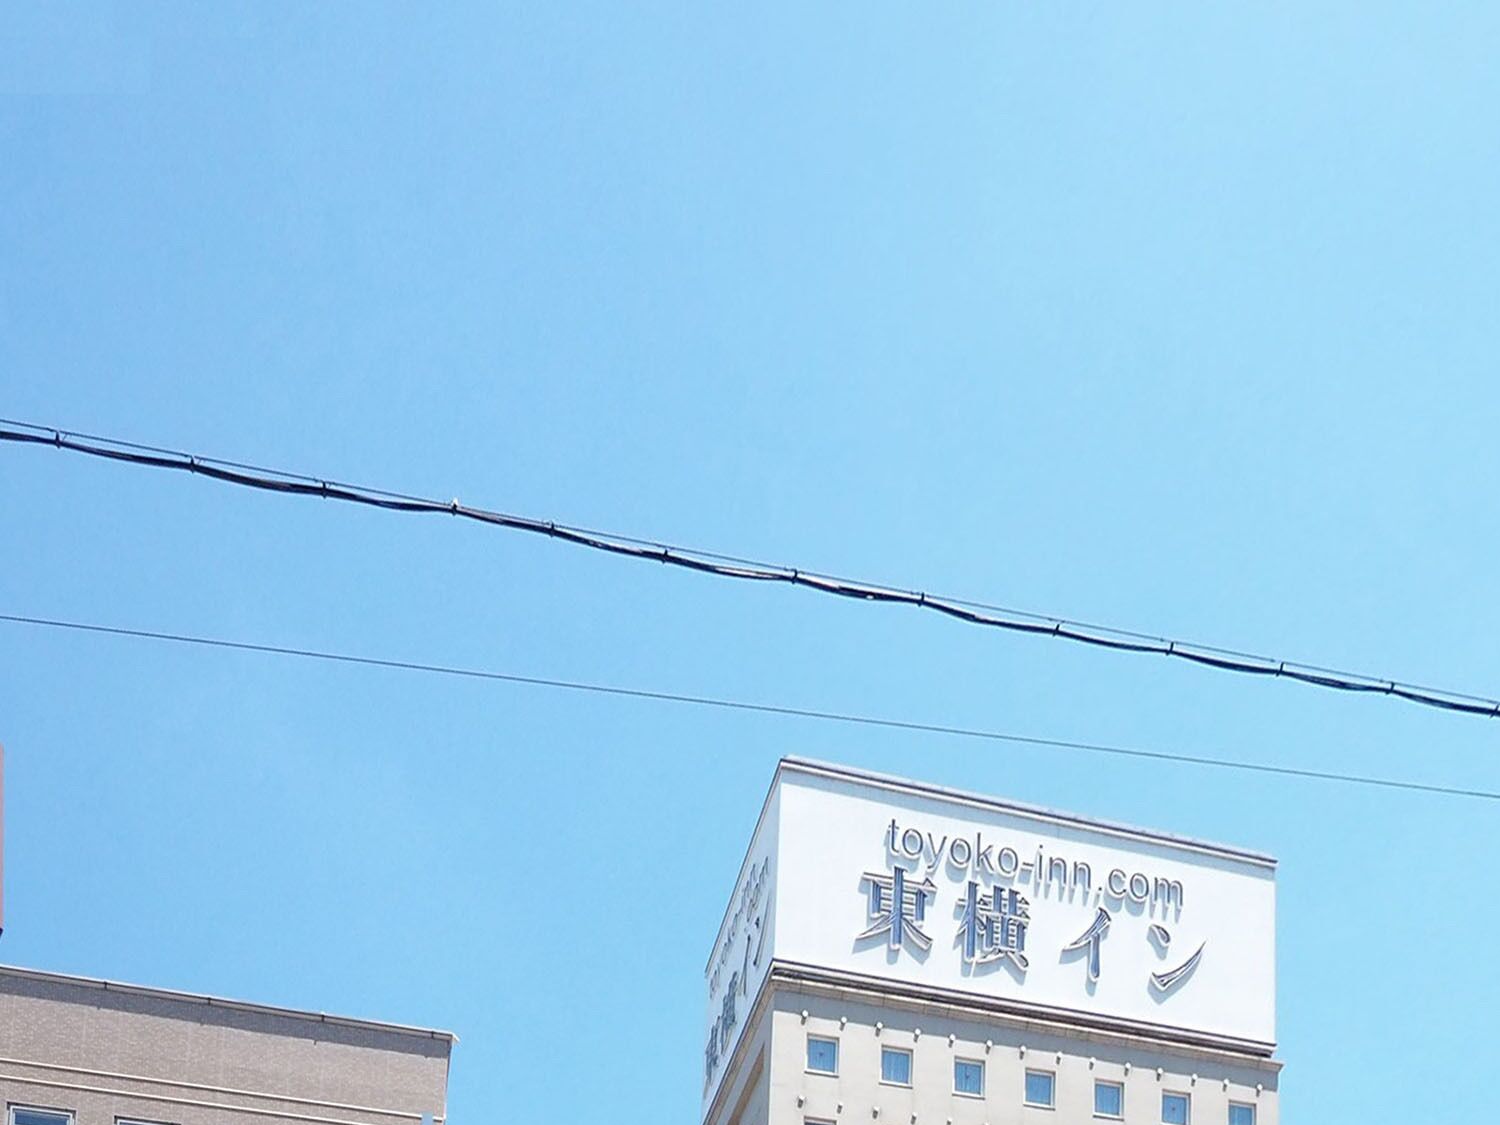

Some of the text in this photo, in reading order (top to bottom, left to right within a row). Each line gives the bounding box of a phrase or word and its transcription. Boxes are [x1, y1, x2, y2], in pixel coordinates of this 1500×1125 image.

[888, 819, 1184, 907] toyoko-inn.com
[855, 866, 1207, 990] 東横イン
